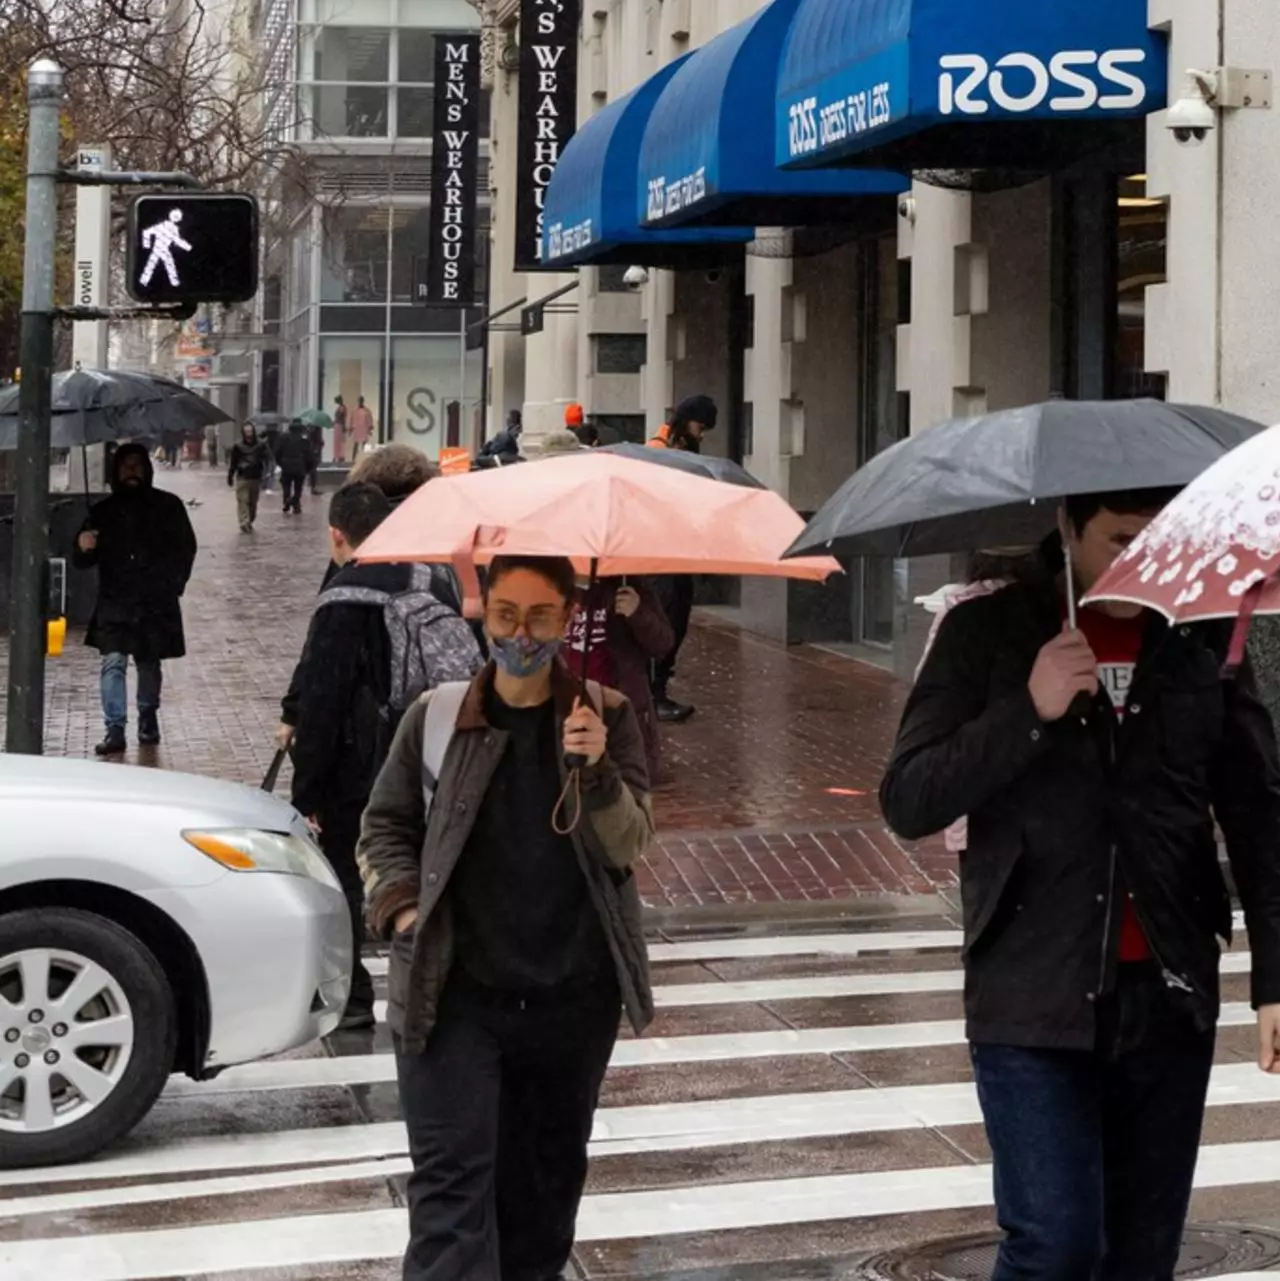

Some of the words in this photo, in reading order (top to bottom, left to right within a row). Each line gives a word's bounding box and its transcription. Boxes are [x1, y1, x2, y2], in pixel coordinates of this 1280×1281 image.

[444, 43, 469, 122] MEN'S
[938, 49, 1146, 114] ROSS
[789, 96, 817, 157] ROSS
[441, 130, 469, 300] WEARHOUSE
[78, 260, 93, 305] owell
